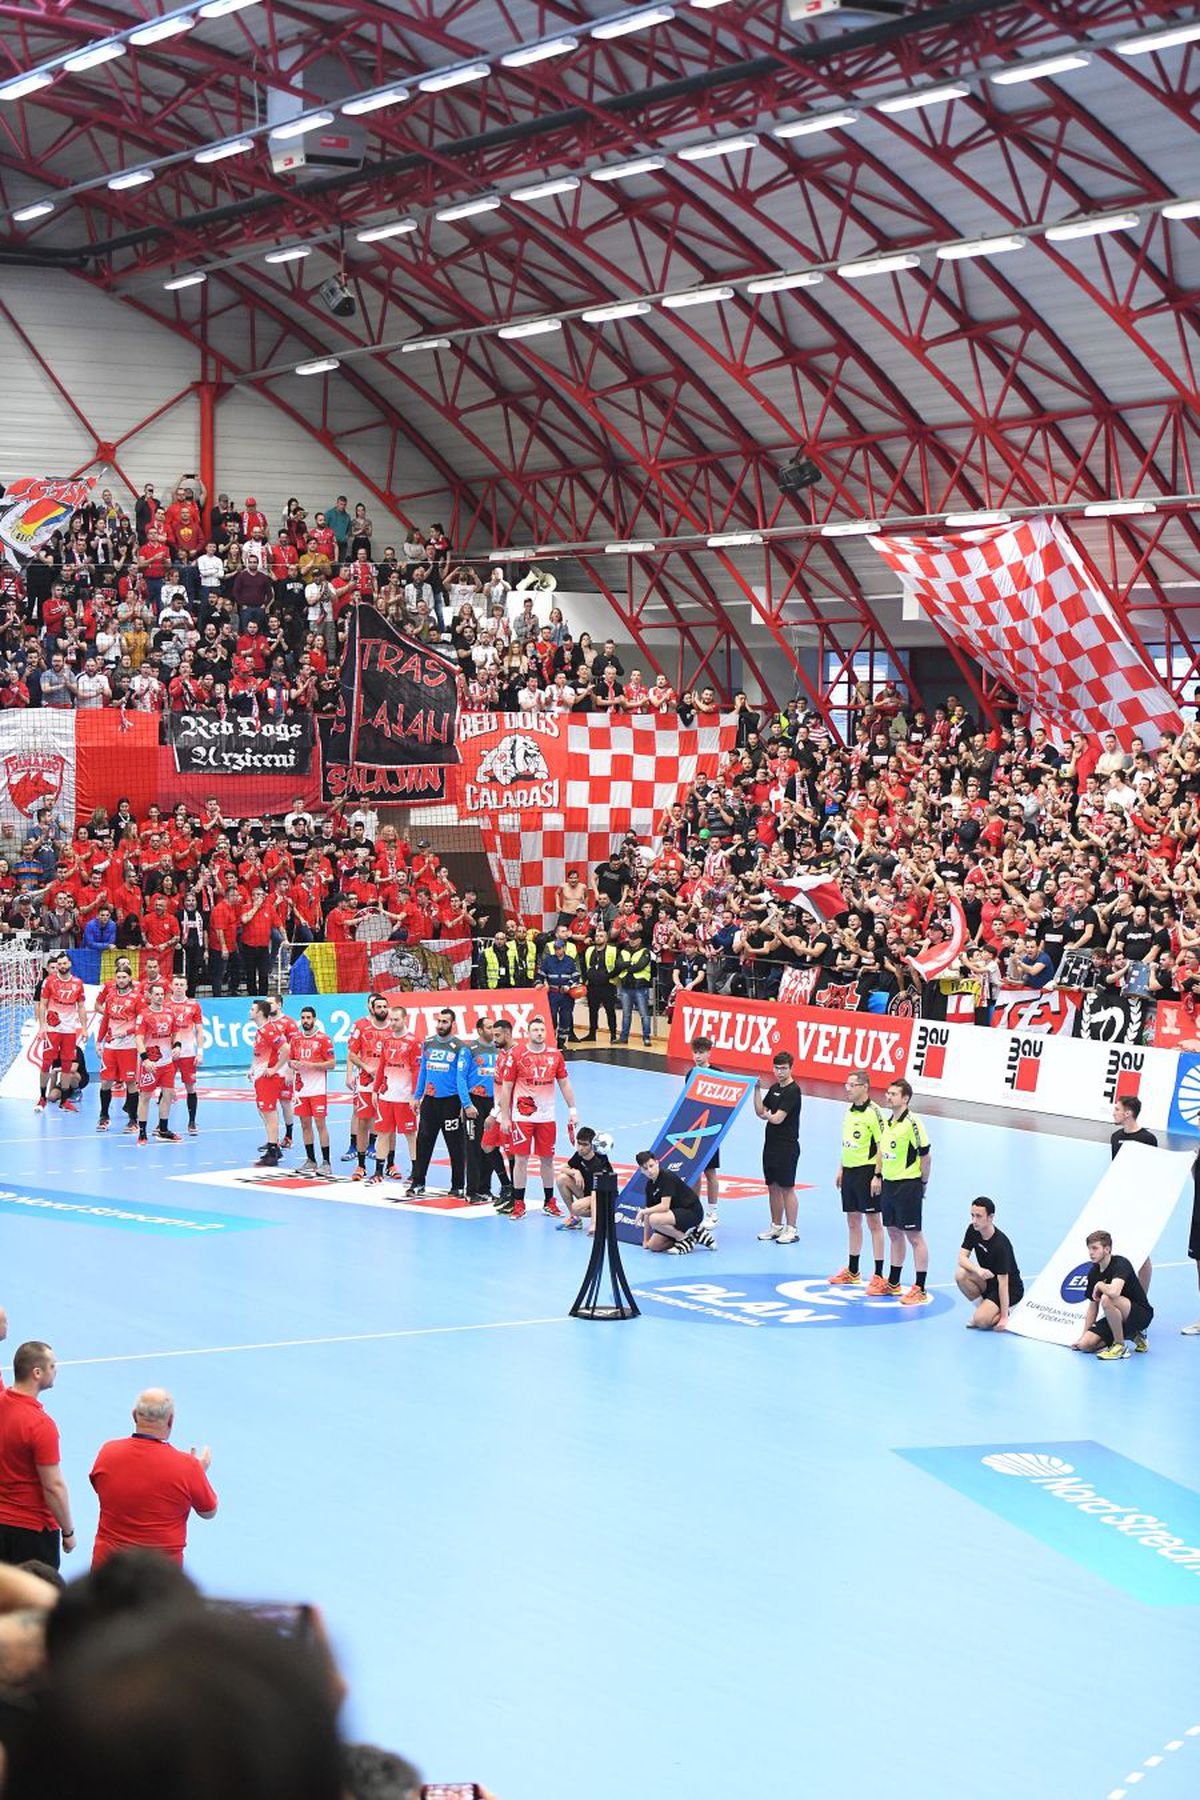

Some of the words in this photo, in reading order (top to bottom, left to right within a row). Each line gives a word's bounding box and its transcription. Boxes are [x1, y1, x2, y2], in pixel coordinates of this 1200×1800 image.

[180, 715, 234, 740] Red
[236, 715, 303, 742] Dogs
[460, 712, 499, 743] RED
[503, 708, 560, 738] DOGS
[190, 746, 296, 771] Urziceni
[464, 777, 560, 812] CALARASI
[59, 989, 73, 999] 77
[330, 1009, 351, 1043] 2
[682, 1007, 777, 1055] VELUX
[300, 1048, 312, 1058] 10
[389, 1048, 397, 1059] 7
[430, 1050, 446, 1060] 23
[797, 1021, 900, 1072] VELUX
[532, 1067, 547, 1078] 17
[695, 1079, 741, 1101] VELUX
[444, 1119, 460, 1131] 23
[653, 1283, 842, 1324] PLAN
[1026, 1476, 1140, 1514] Nord
